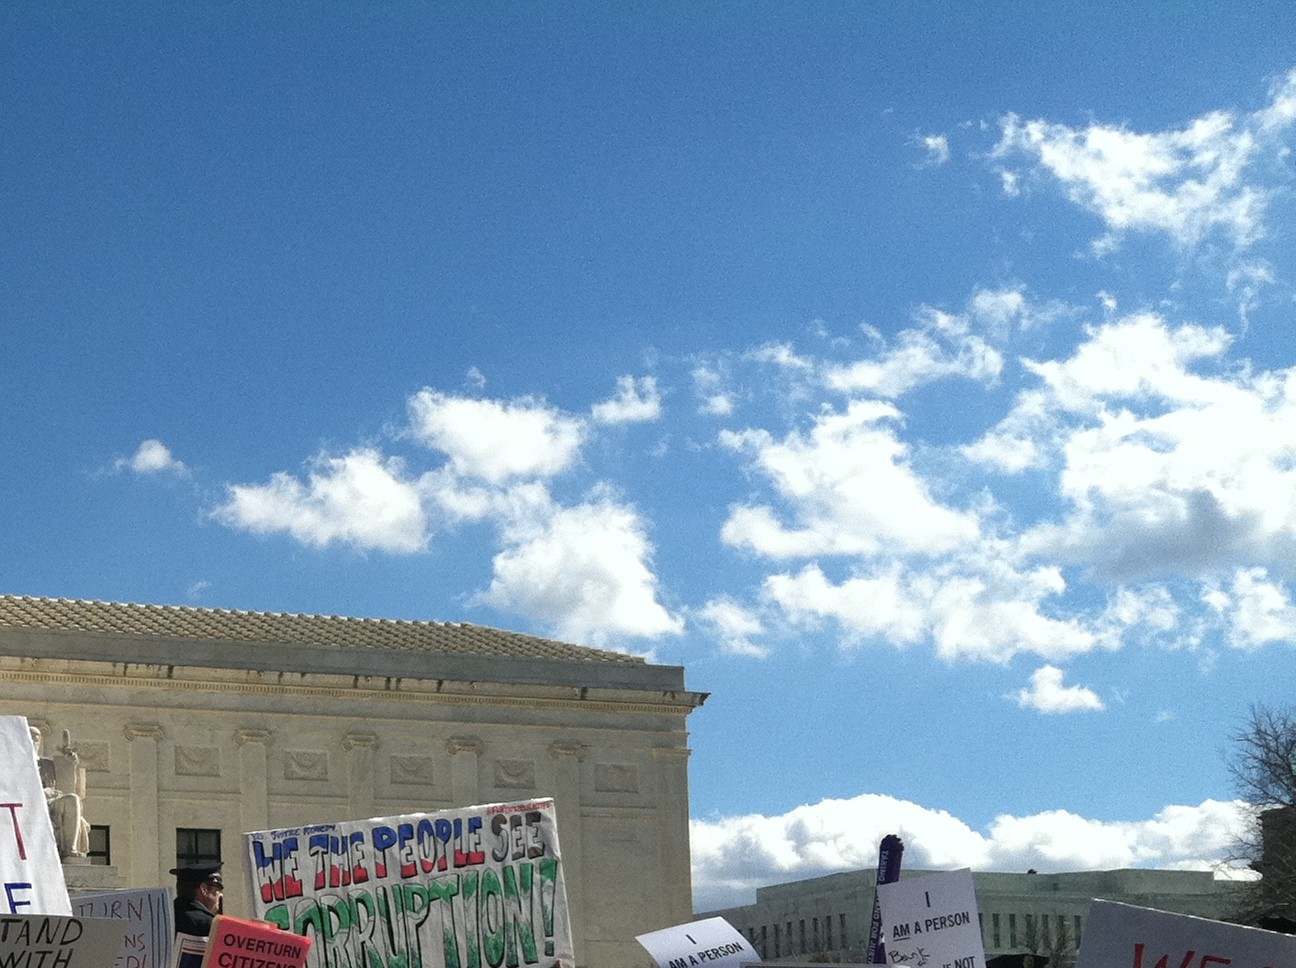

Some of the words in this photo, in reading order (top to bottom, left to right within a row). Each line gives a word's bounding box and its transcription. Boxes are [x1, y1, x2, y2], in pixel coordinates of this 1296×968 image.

[254, 837, 303, 904] WE
[308, 829, 370, 891] THE
[371, 816, 486, 879] PEOPLE
[491, 811, 546, 863] SEE
[925, 891, 931, 908] I
[893, 923, 910, 938] AM
[914, 920, 922, 934] A
[924, 911, 971, 933] PERSON
[223, 933, 302, 959] OVERTURN
[685, 933, 697, 945] I
[688, 954, 700, 967] A
[697, 941, 745, 963] PERSON
